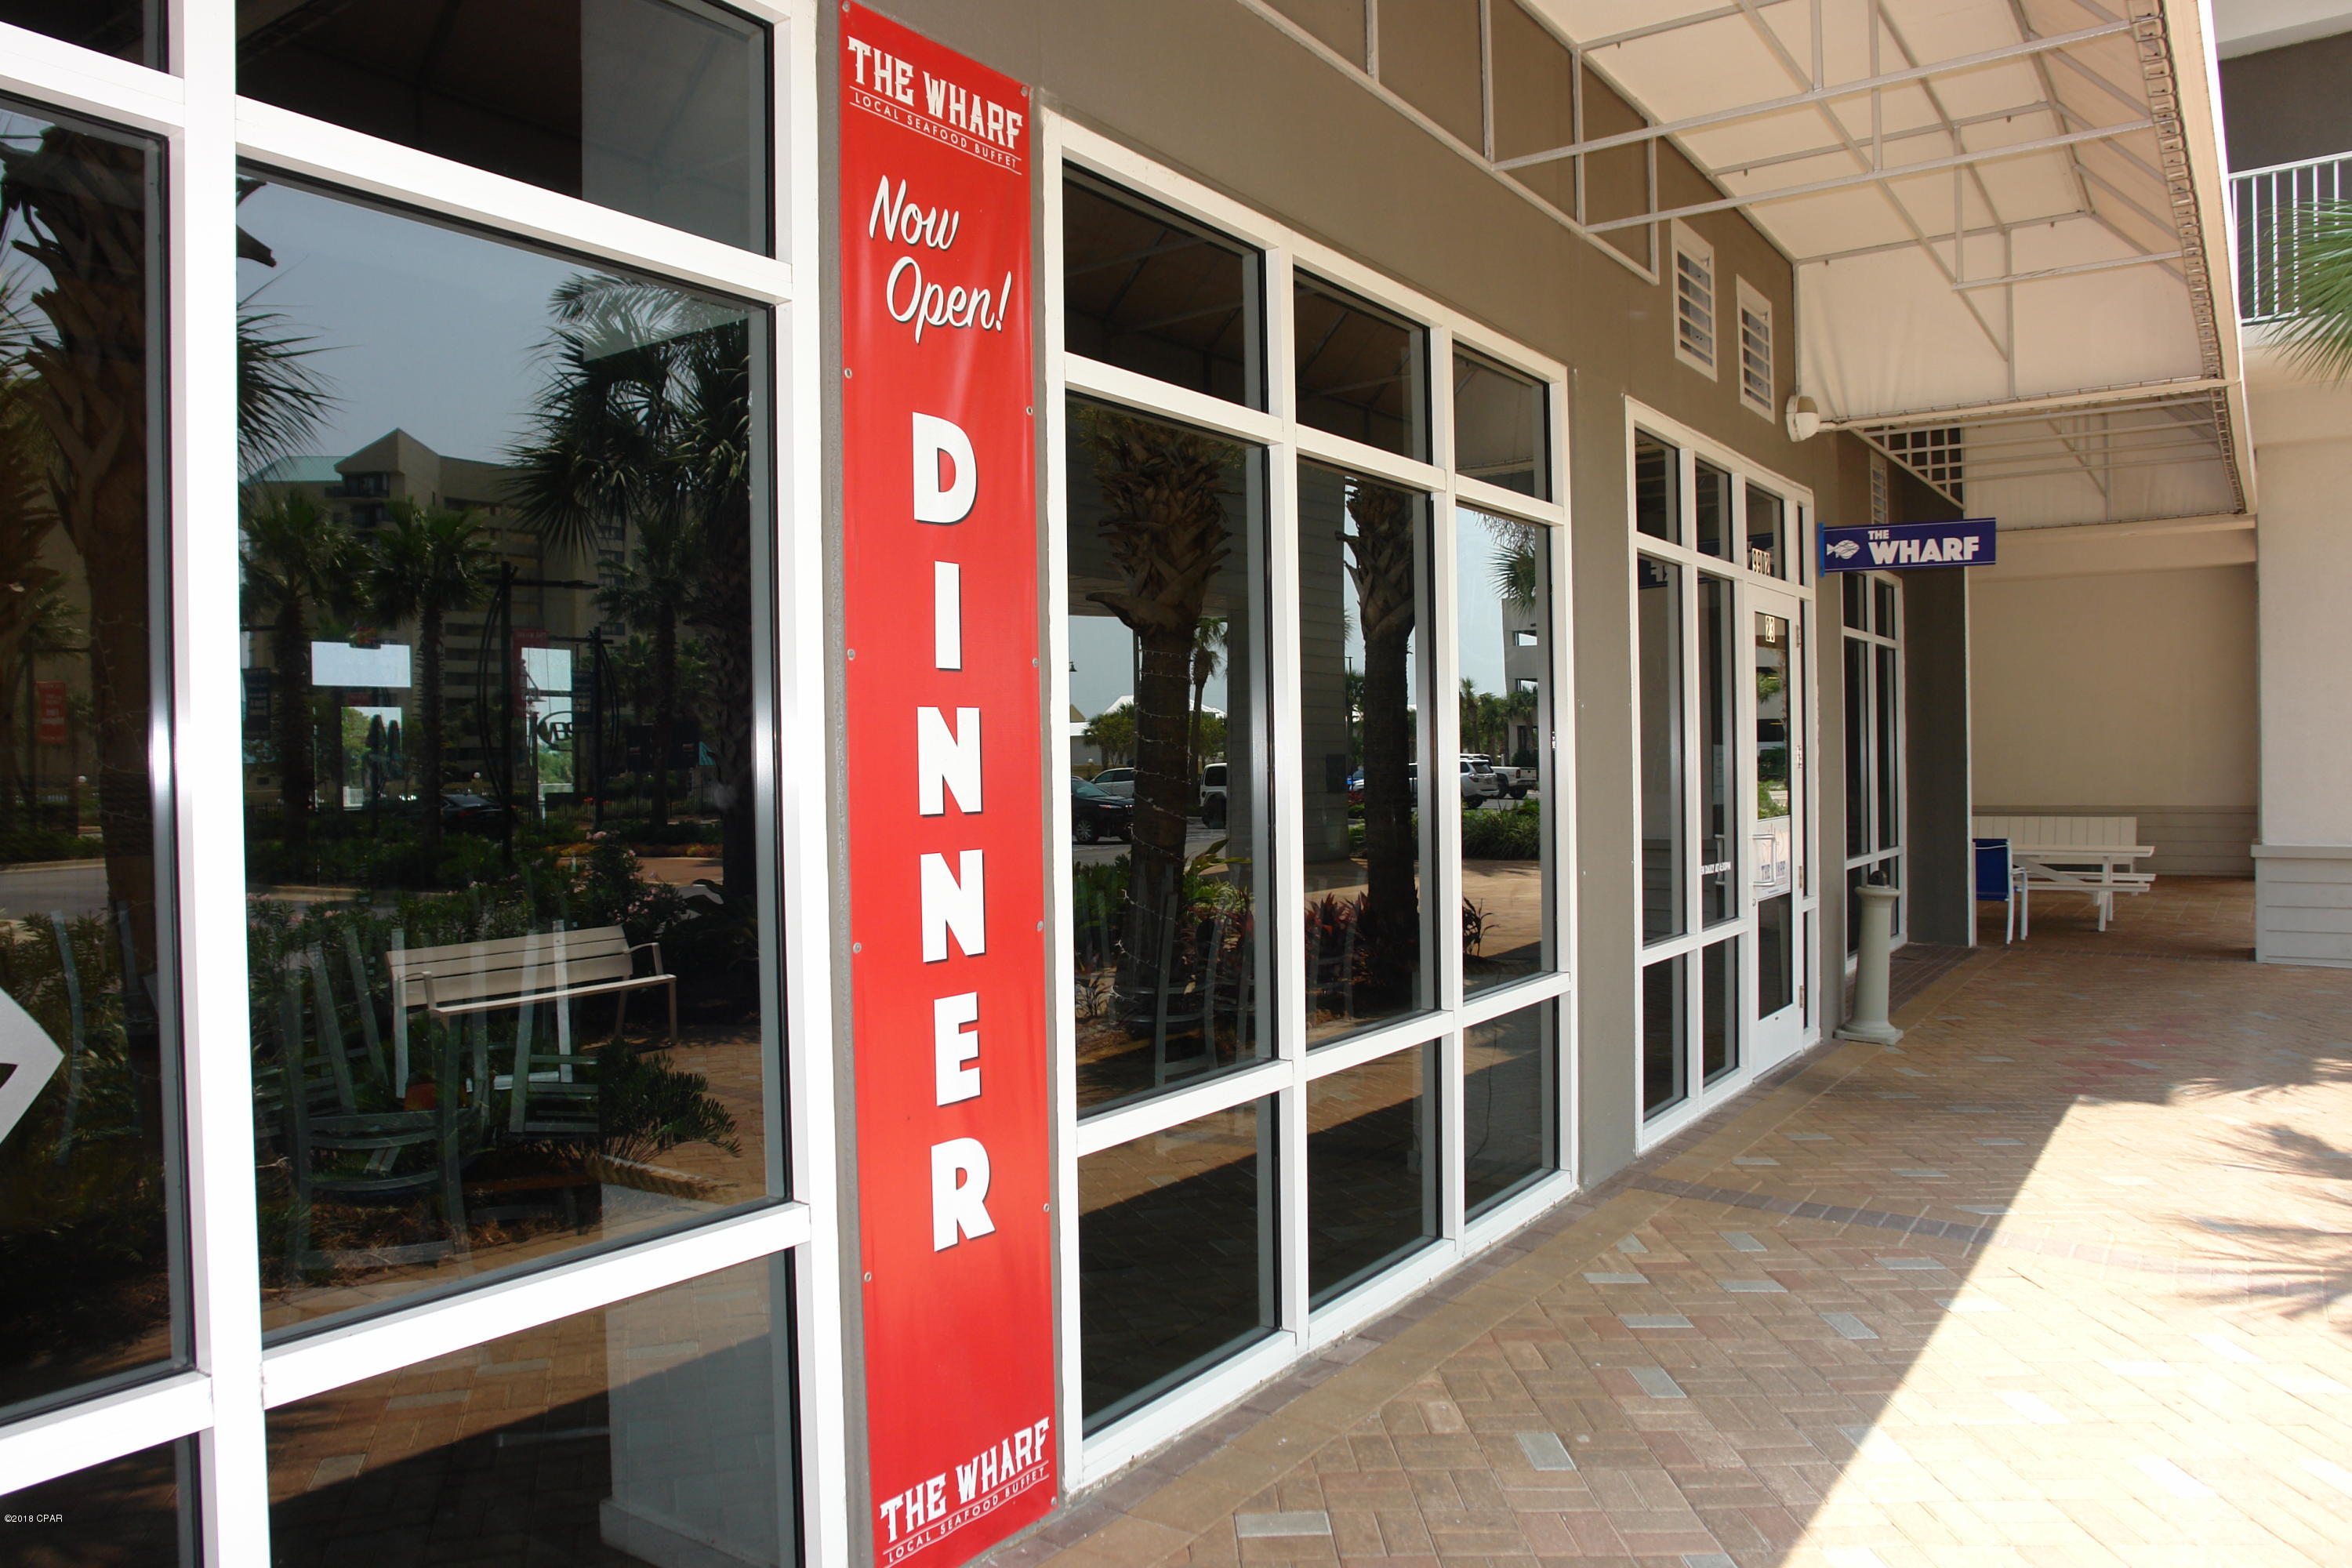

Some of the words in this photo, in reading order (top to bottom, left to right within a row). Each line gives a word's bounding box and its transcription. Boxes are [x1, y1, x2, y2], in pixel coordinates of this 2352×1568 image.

[847, 35, 914, 107] THE
[923, 71, 1022, 150] WHARF
[855, 93, 898, 119] LOCAL
[907, 114, 967, 148] SEAFOOD
[975, 143, 1016, 169] BUFFET
[869, 175, 959, 250] Now
[887, 256, 1011, 344] Open!
[1753, 550, 1769, 576] 9902
[1867, 529, 1889, 540] THE
[1867, 536, 1980, 564] WHARF
[912, 412, 996, 1252] DINNER
[880, 1472, 947, 1543] THE
[955, 1417, 1049, 1504] WHARF
[889, 1534, 931, 1563] LOCAL
[940, 1497, 998, 1535] SEAFOOD
[1005, 1467, 1044, 1497] BUFFET
